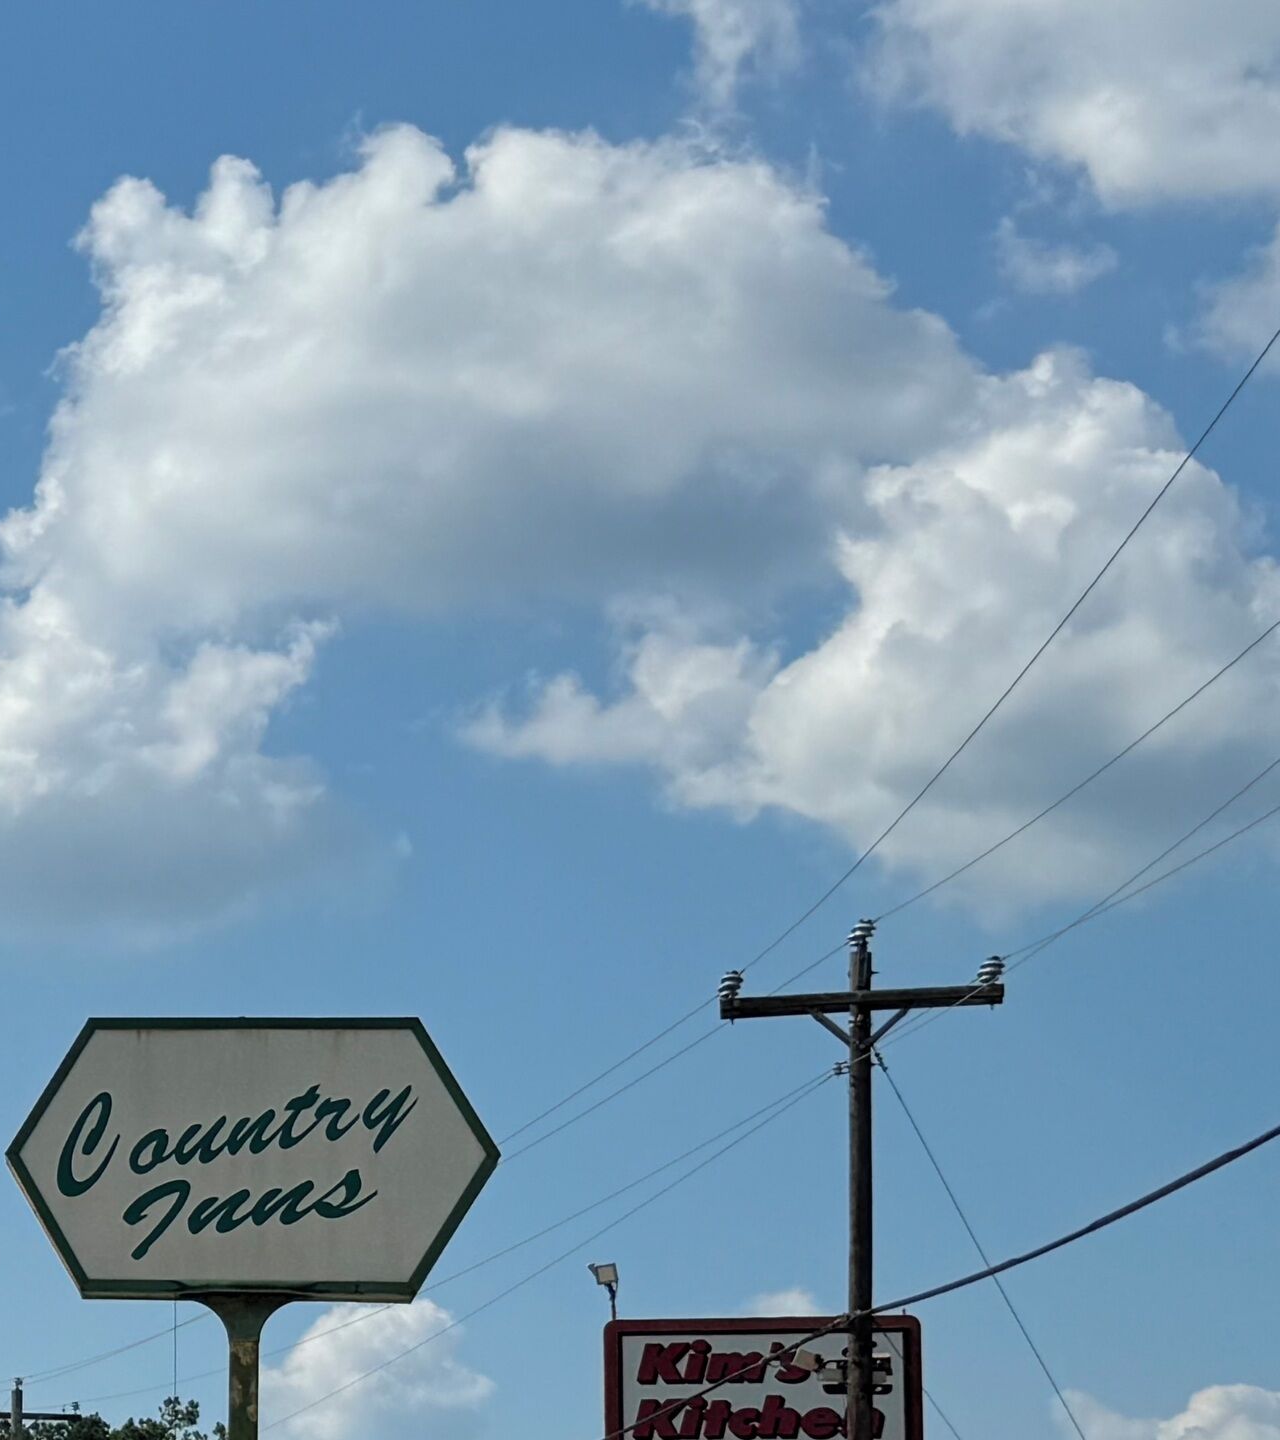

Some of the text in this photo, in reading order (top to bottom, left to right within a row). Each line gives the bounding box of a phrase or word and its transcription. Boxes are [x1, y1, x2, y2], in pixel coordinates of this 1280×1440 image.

[56, 1083, 419, 1198] Country
[123, 1168, 378, 1260] Inns
[637, 1339, 811, 1384] Kim's
